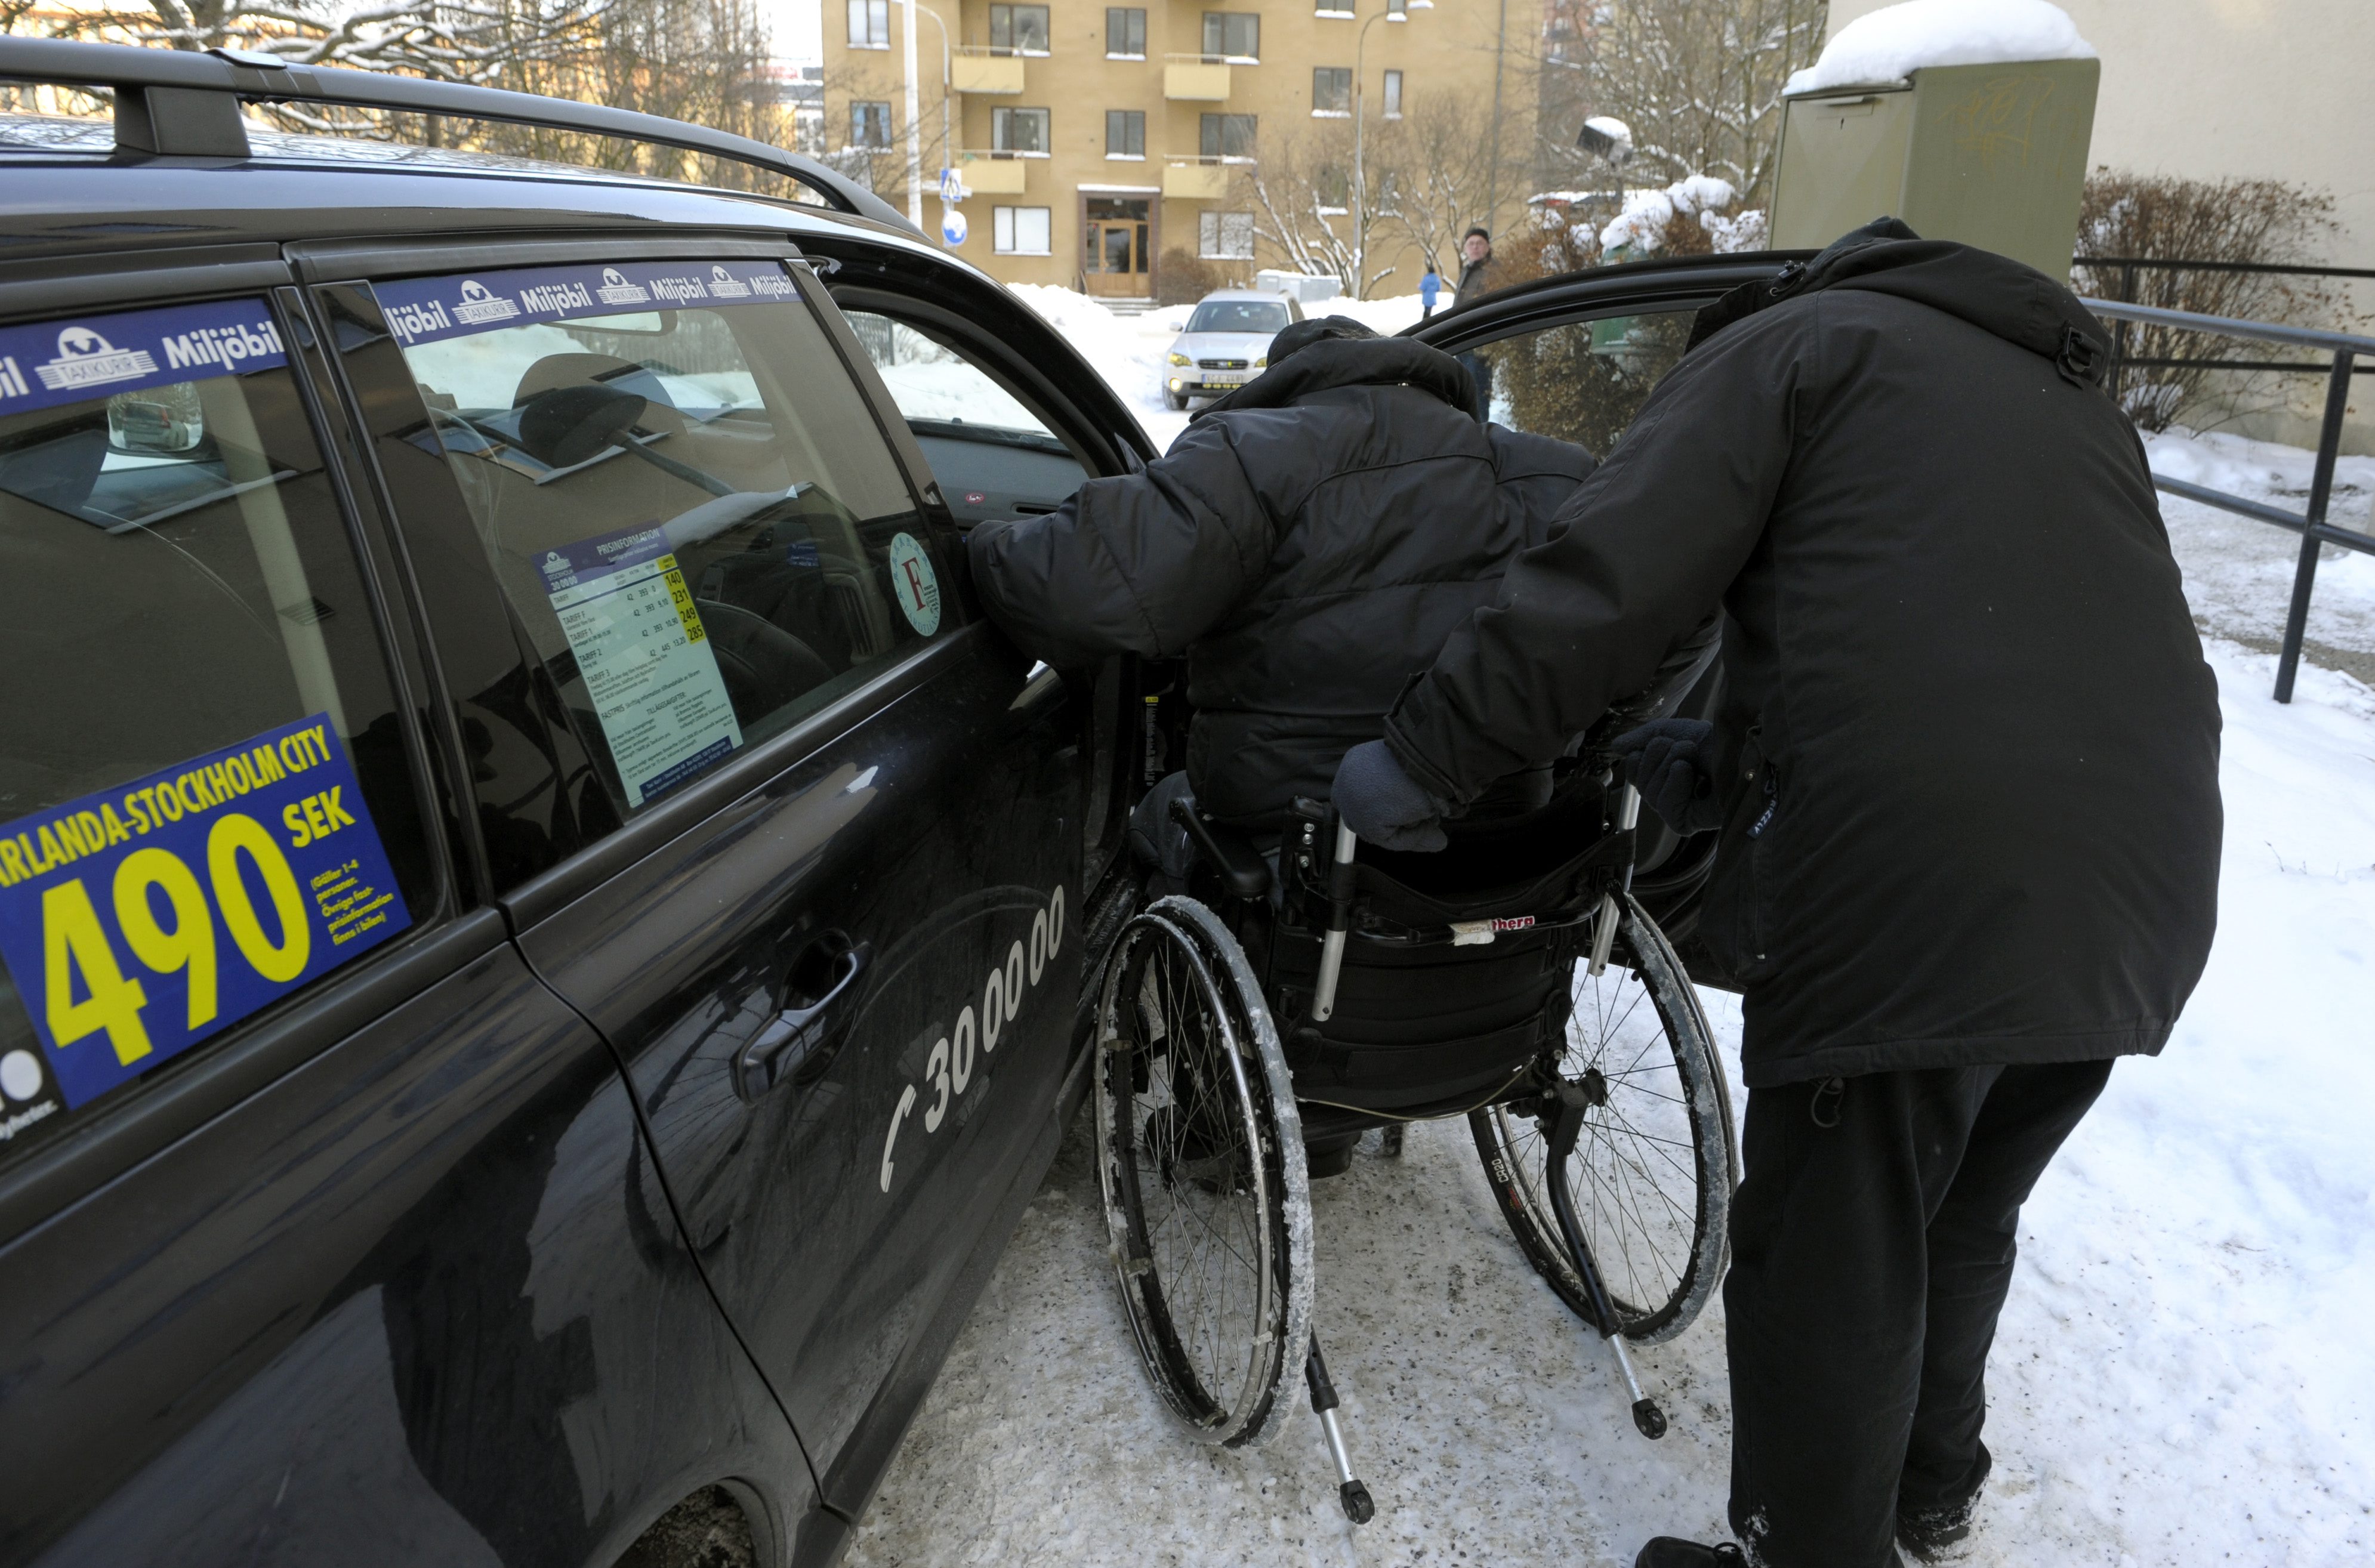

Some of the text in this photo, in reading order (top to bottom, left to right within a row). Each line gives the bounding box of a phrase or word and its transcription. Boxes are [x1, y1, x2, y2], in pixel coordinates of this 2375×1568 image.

[519, 282, 593, 316] Miljöbil
[649, 277, 708, 305] Miljöbil
[749, 274, 797, 300] Miljöbil
[162, 320, 285, 371] Miljöbil
[597, 529, 659, 555] PRISINFORMATION
[665, 572, 681, 587] 140
[901, 557, 926, 612] F
[644, 604, 655, 612] 393
[673, 589, 689, 604] 231
[563, 613, 582, 624] TARIFF
[653, 624, 663, 632] 393
[680, 607, 696, 622] 249
[570, 630, 588, 641] TARIFF
[687, 625, 703, 640] 285
[579, 651, 597, 662] TARIFF
[587, 672, 605, 683] TARIFF
[279, 724, 332, 773] CITY
[282, 785, 357, 848] SEK
[42, 813, 310, 1068] 490
[925, 885, 1064, 1133] 30 00 00
